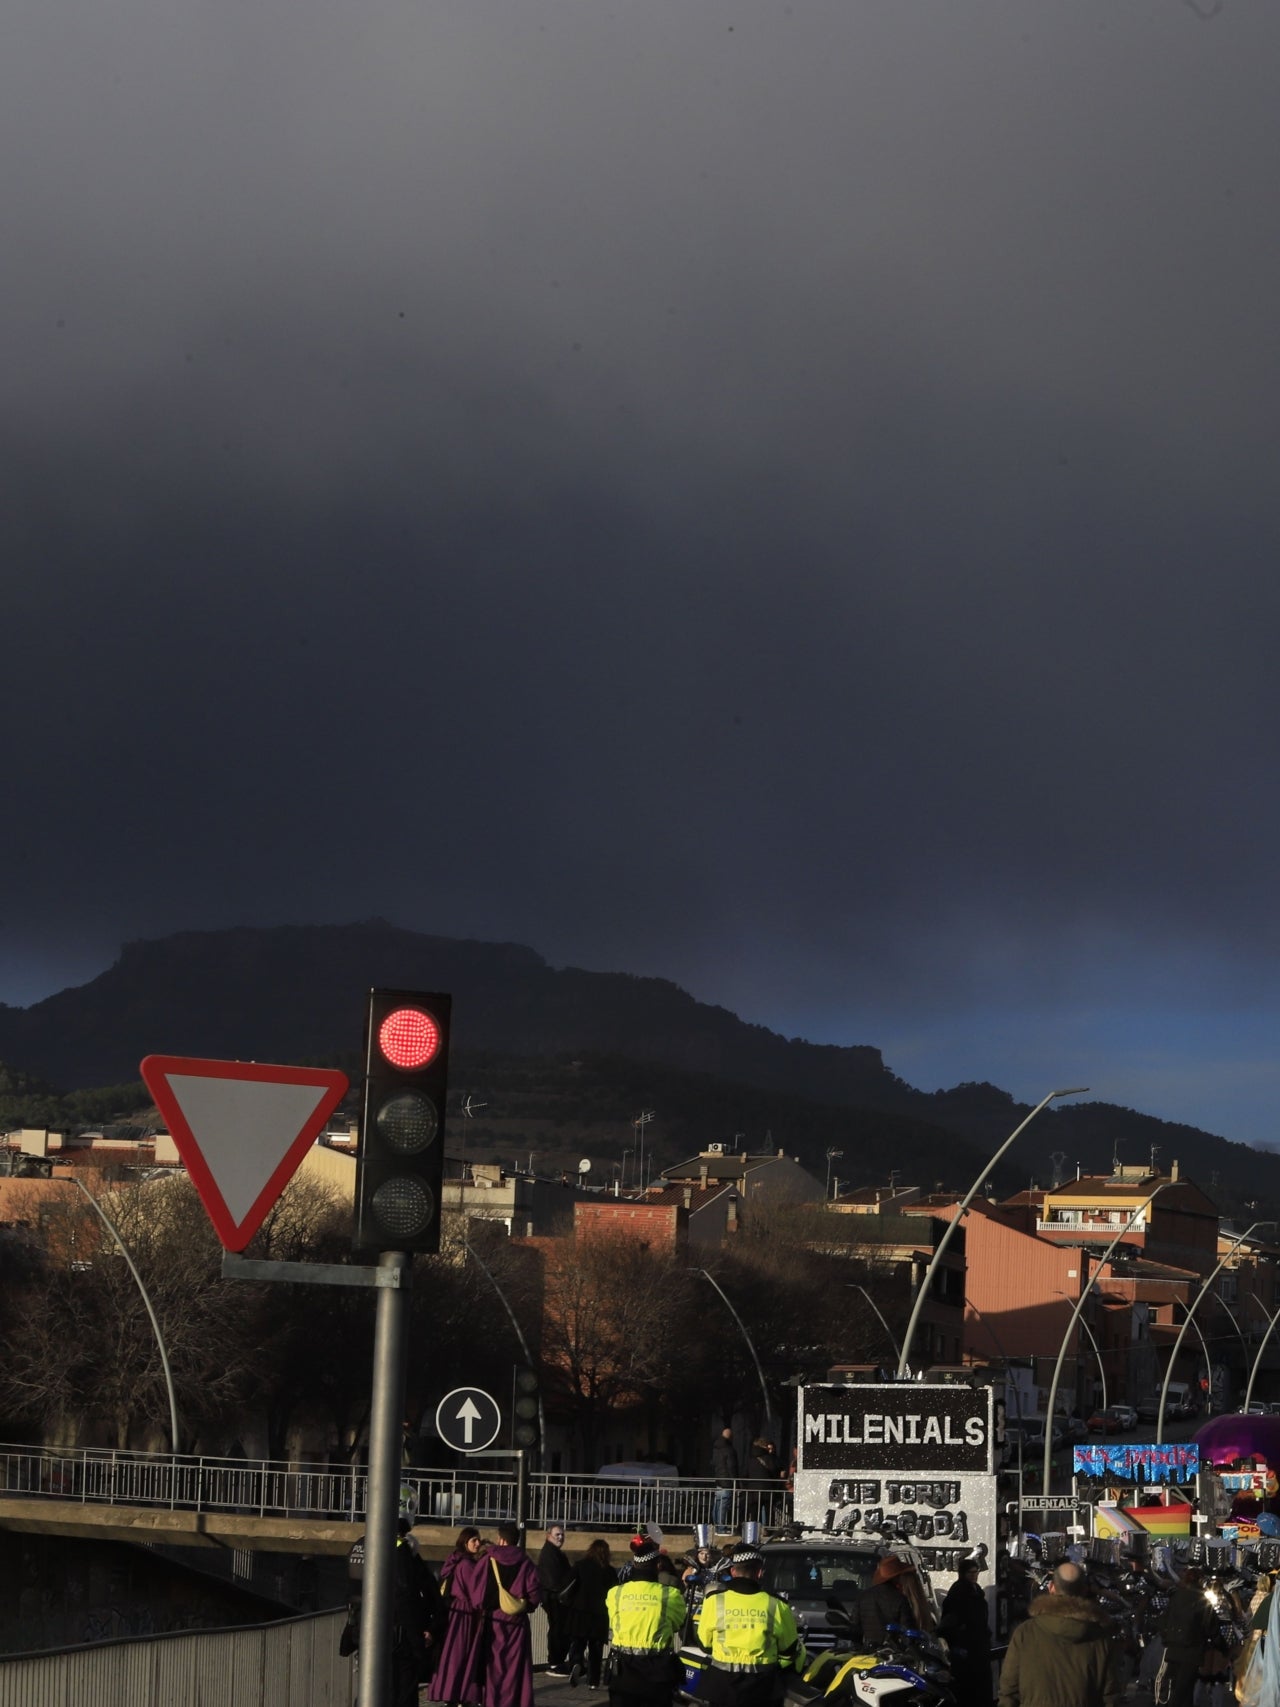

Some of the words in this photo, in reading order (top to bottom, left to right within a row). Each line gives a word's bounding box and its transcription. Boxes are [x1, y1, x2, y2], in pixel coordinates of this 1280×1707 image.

[805, 1414, 985, 1446] MILENIALS
[829, 1479, 881, 1509] QUE
[1020, 1498, 1078, 1509] MILENIALS
[725, 1608, 767, 1617] POLICIA
